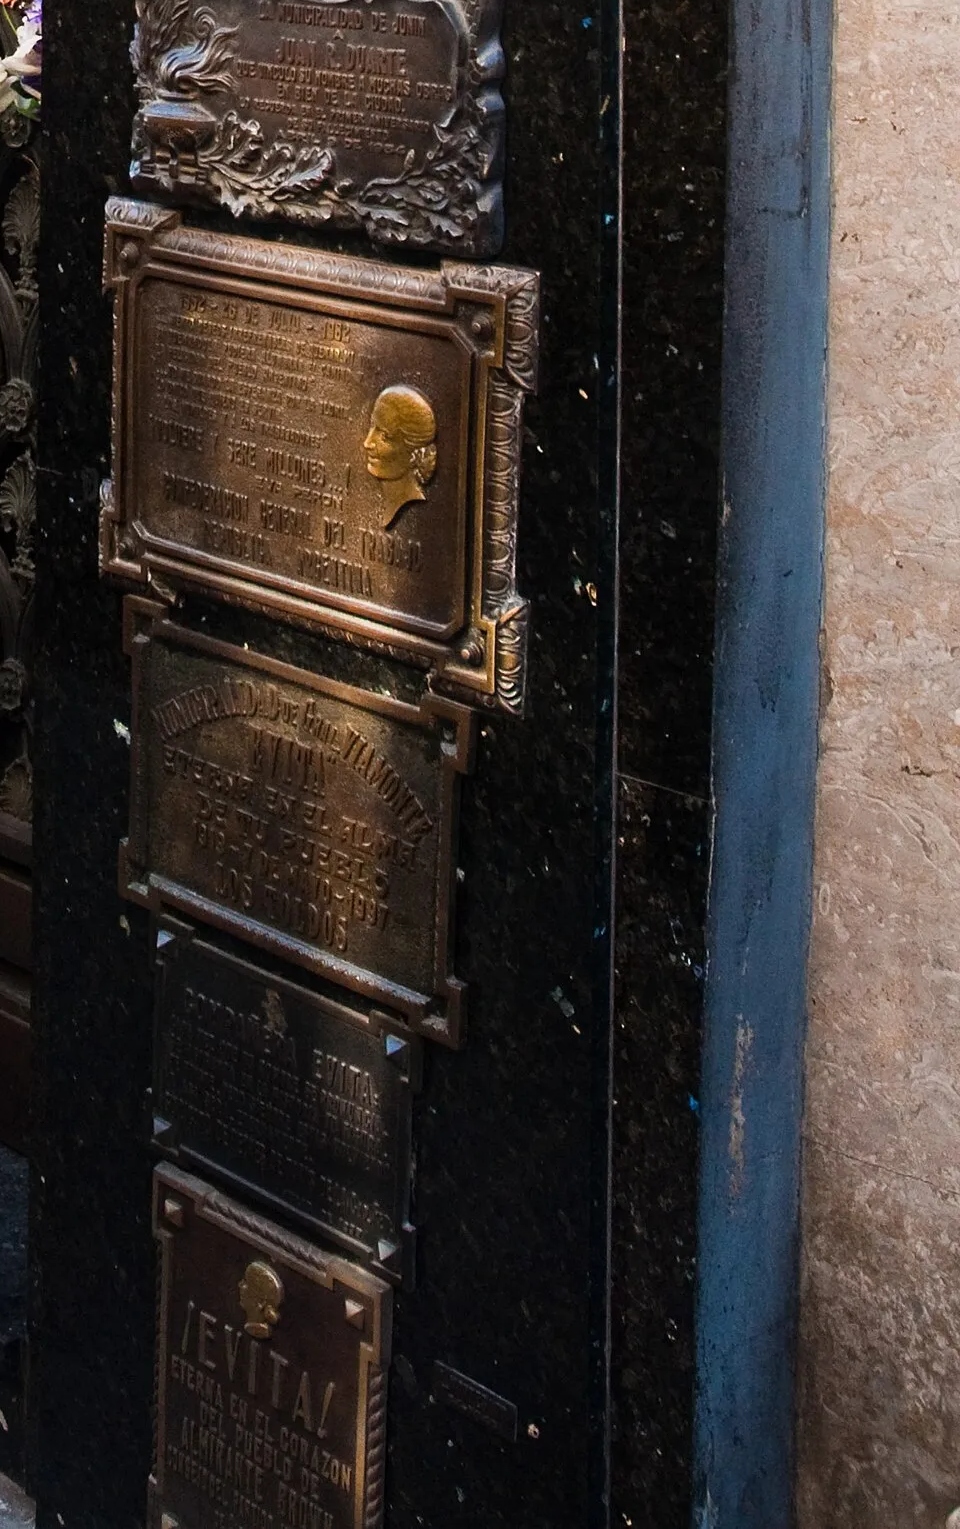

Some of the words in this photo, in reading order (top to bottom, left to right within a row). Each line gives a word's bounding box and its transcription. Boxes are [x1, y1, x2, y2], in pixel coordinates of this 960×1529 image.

[279, 2, 363, 31] MUNICIPALIDAD
[371, 10, 387, 33] DE
[275, 36, 317, 68] JUAN
[346, 43, 409, 76] DUARTE
[314, 68, 355, 91] NOMBRE
[196, 790, 230, 823] DE
[280, 828, 390, 899] PUEBLO
[171, 1353, 224, 1413] ETERNA
[229, 1392, 248, 1424] EN
[255, 1410, 275, 1442] EL
[279, 1423, 353, 1492] CORAZON
[199, 1402, 228, 1441] DEL
[234, 1422, 293, 1483] PUEBLO
[300, 1467, 321, 1500] DE
